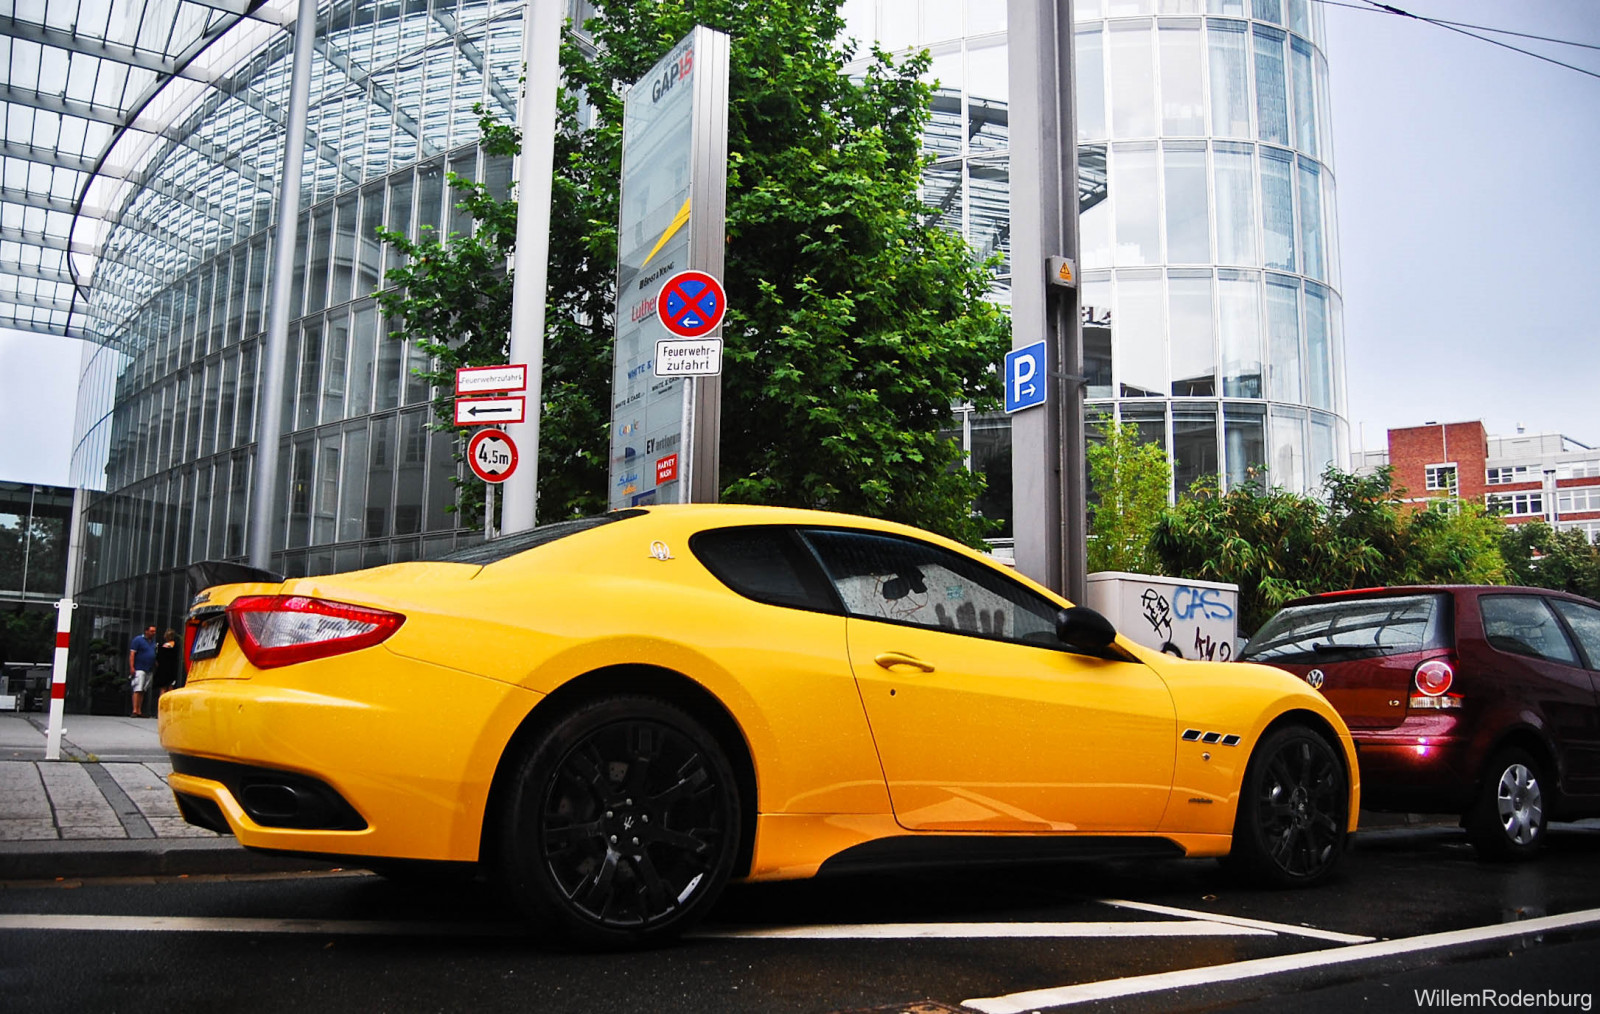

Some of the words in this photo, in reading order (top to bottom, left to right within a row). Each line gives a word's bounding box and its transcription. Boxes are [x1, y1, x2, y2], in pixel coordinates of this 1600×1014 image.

[652, 49, 693, 103] GAP15
[663, 346, 715, 356] Feuerwehr-
[667, 360, 709, 370] zufahrt
[1014, 354, 1036, 402] P
[657, 458, 675, 470] HARVEY
[659, 469, 672, 479] NASH
